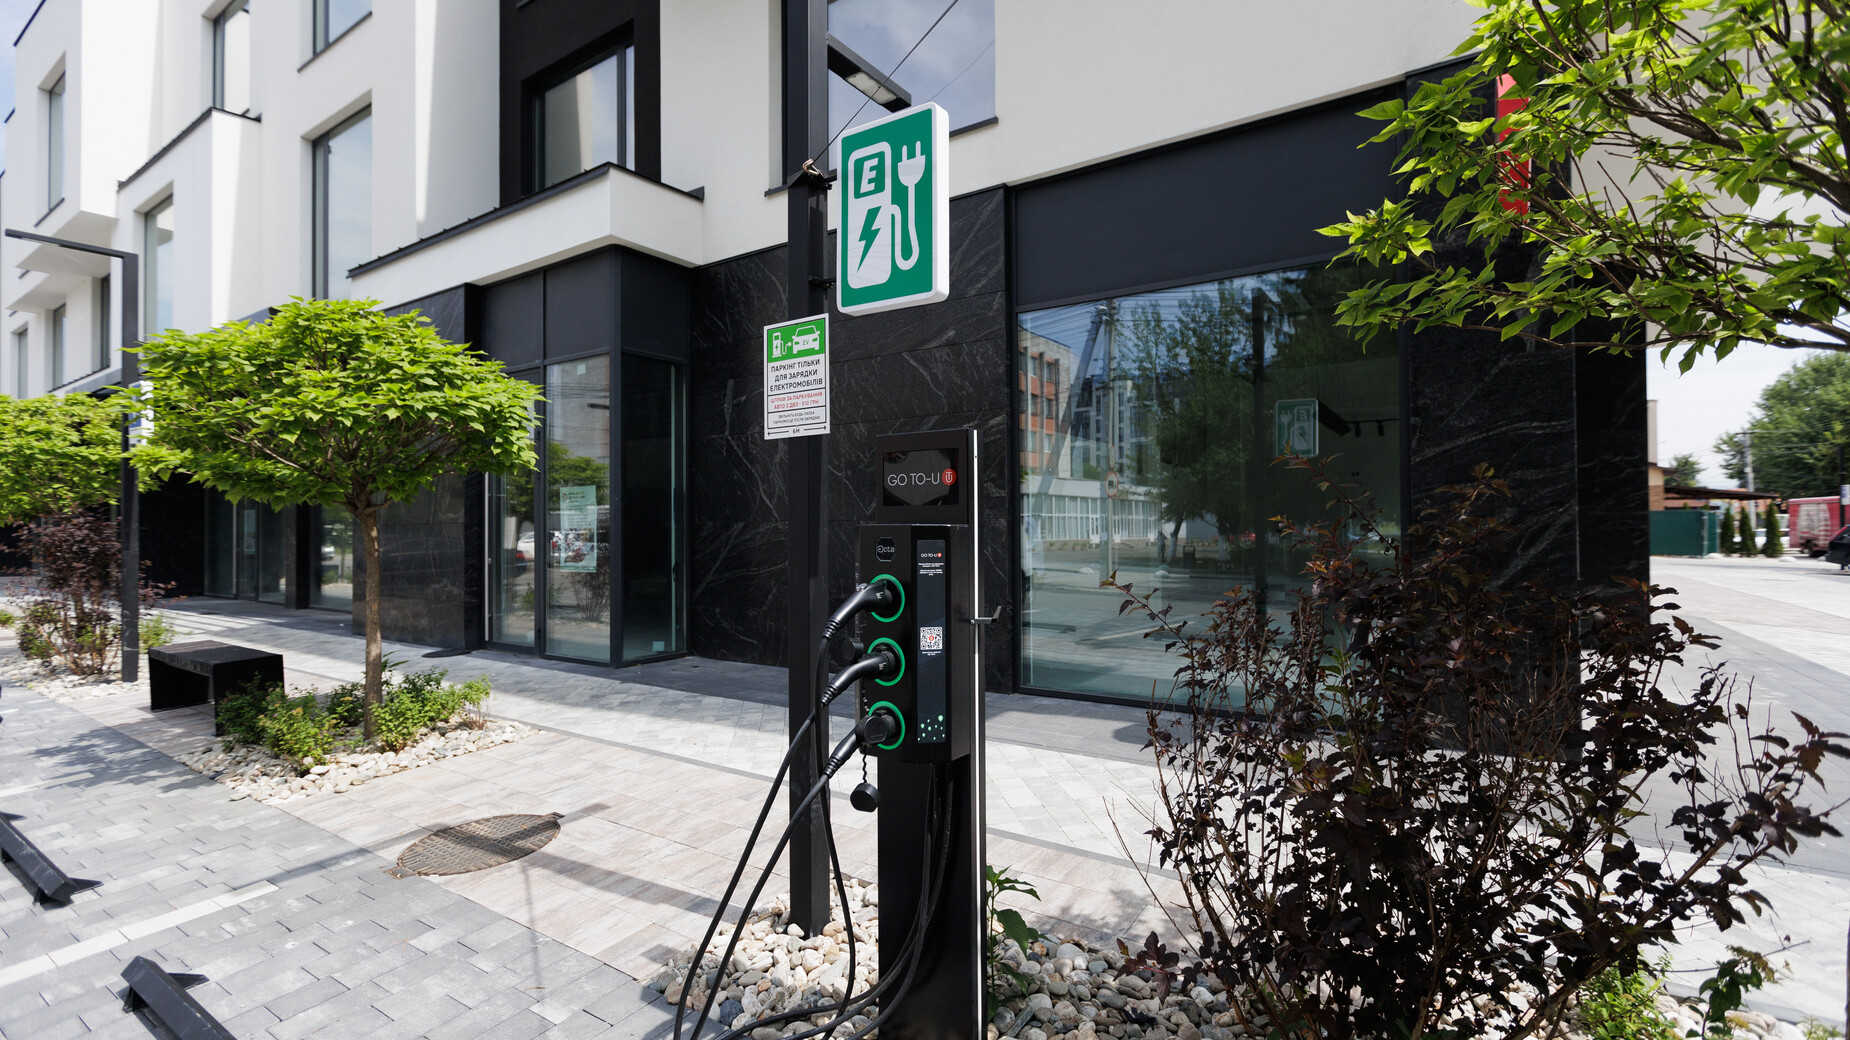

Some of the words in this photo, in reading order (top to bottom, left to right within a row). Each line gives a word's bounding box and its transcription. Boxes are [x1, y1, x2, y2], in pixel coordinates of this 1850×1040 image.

[860, 157, 878, 194] E
[770, 362, 796, 372] ПАРКІНГ
[797, 358, 820, 368] ТІЛЬКИ
[774, 374, 788, 382] ДЛЯ
[788, 369, 818, 380] ЗАРЯДКИ
[770, 378, 822, 392] ЕЛЕКТРОМОБІЛІВ
[792, 392, 822, 400] ПАРКУВАННЯ
[888, 474, 908, 486] GO
[910, 472, 940, 485] TO-U
